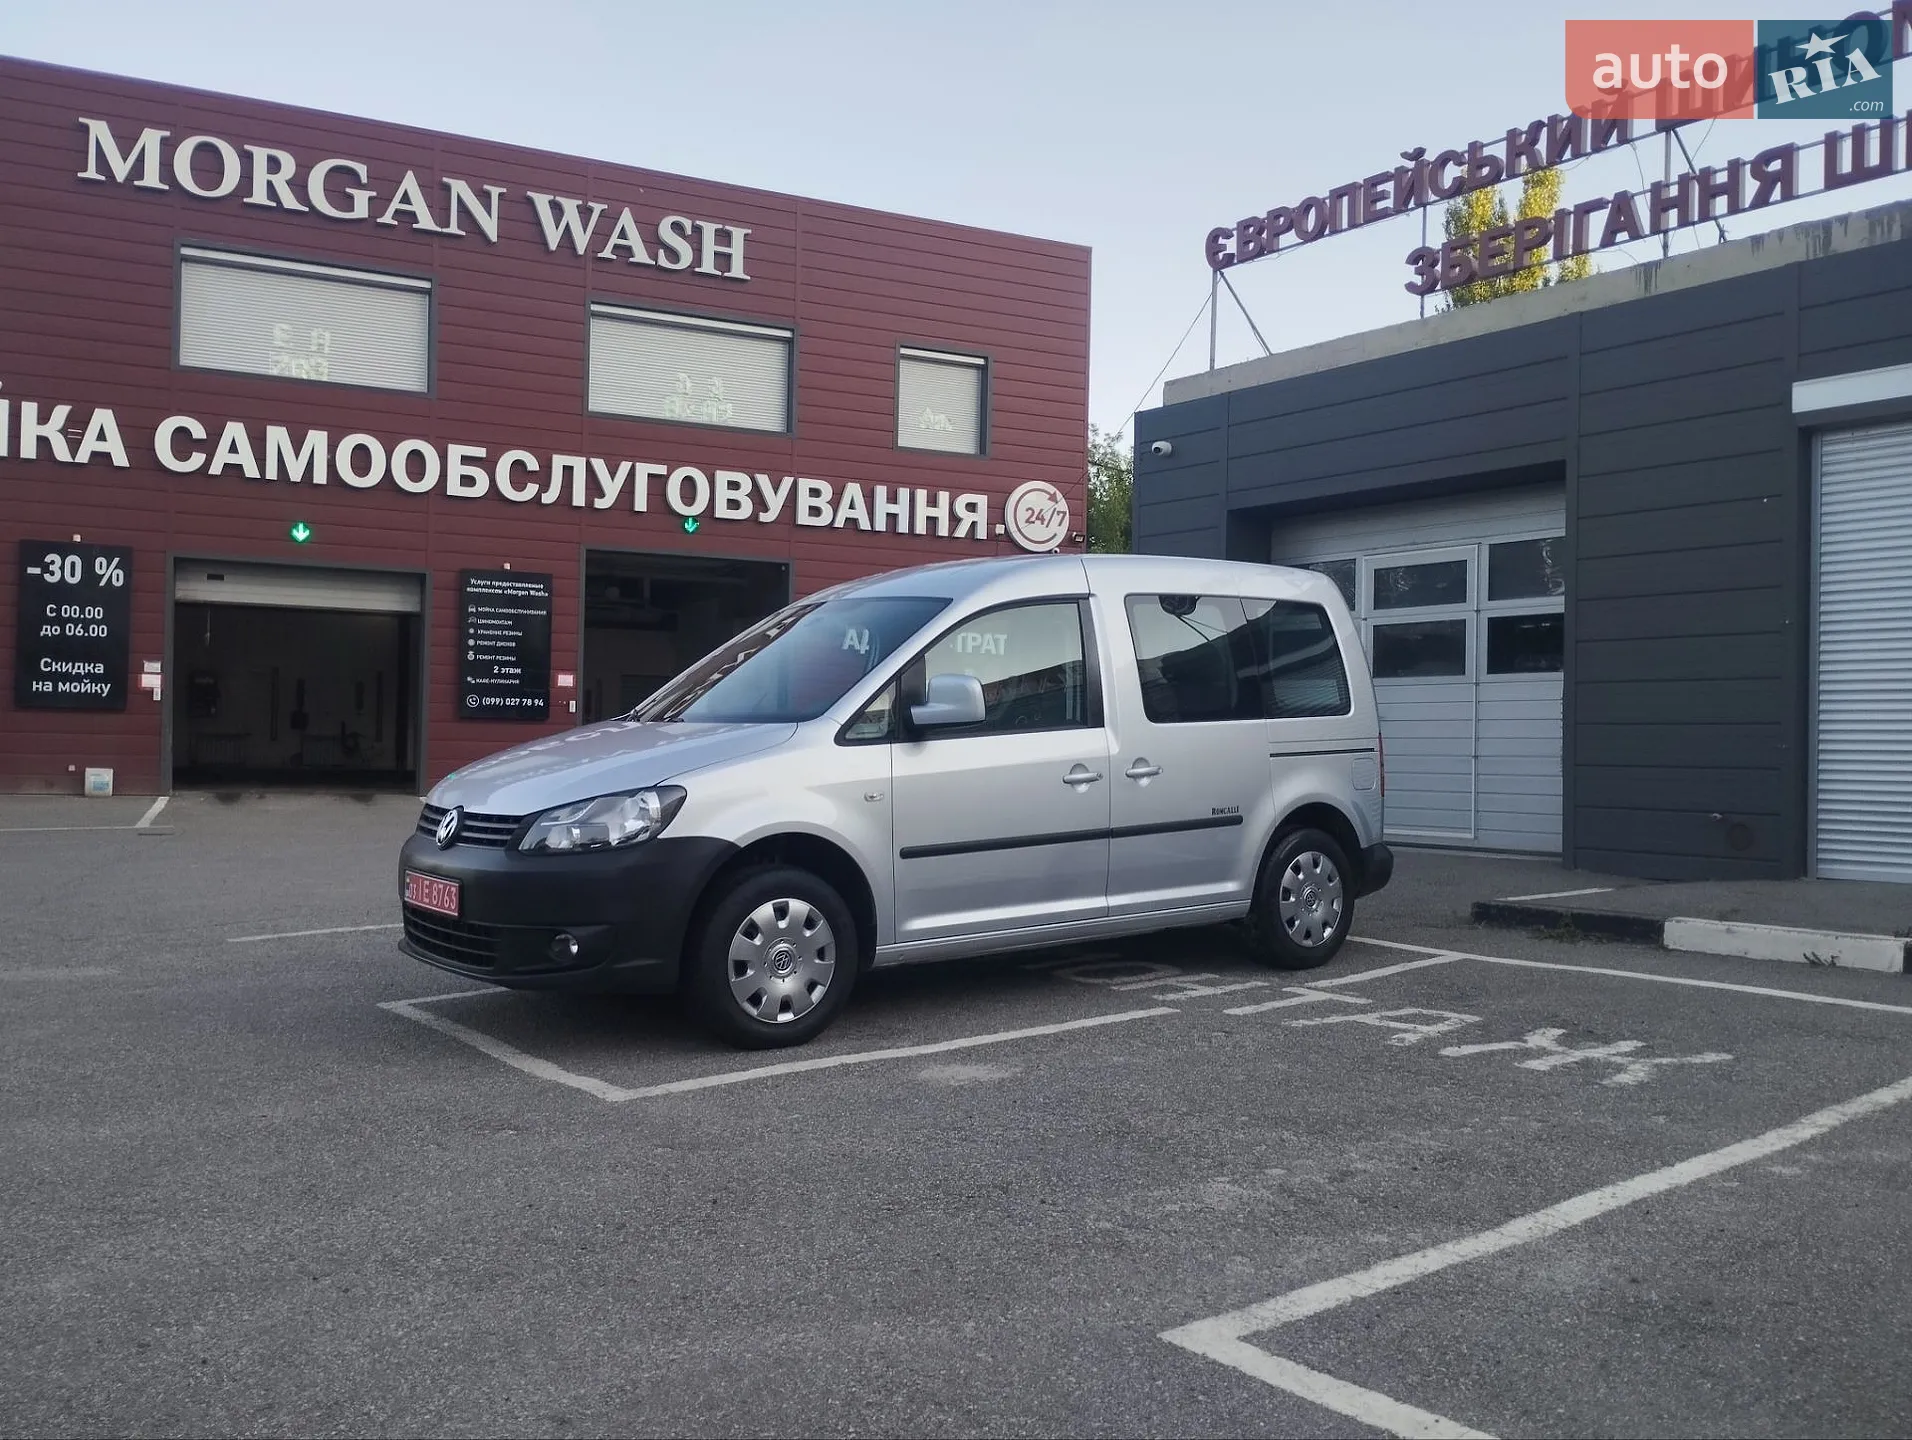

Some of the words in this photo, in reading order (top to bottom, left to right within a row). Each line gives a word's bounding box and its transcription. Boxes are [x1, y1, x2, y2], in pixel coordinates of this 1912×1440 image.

[1206, 78, 1636, 270] ЄВРОПЕЙСЬКИЙ
[1655, 0, 1912, 132] ШИНО
[77, 116, 507, 244] MORGAN
[527, 190, 752, 280] WASH
[1404, 142, 1800, 297] ЗБЕРІГАННЯ
[1824, 109, 1912, 191] Ш
[154, 415, 988, 540] САМООБСЛУГОВУВАННЯ
[1025, 506, 1068, 529] 24/7
[26, 553, 83, 585] -30
[94, 556, 125, 587] %
[61, 605, 104, 619] 00.00
[40, 625, 61, 637] до
[65, 623, 108, 637] 06.00
[40, 658, 104, 676] Скидка
[493, 665, 500, 674] 2
[32, 681, 53, 692] на
[58, 679, 112, 697] мойку
[482, 696, 504, 706] (099)
[505, 697, 520, 706] 027
[522, 698, 532, 706] 78
[533, 699, 544, 707] 94
